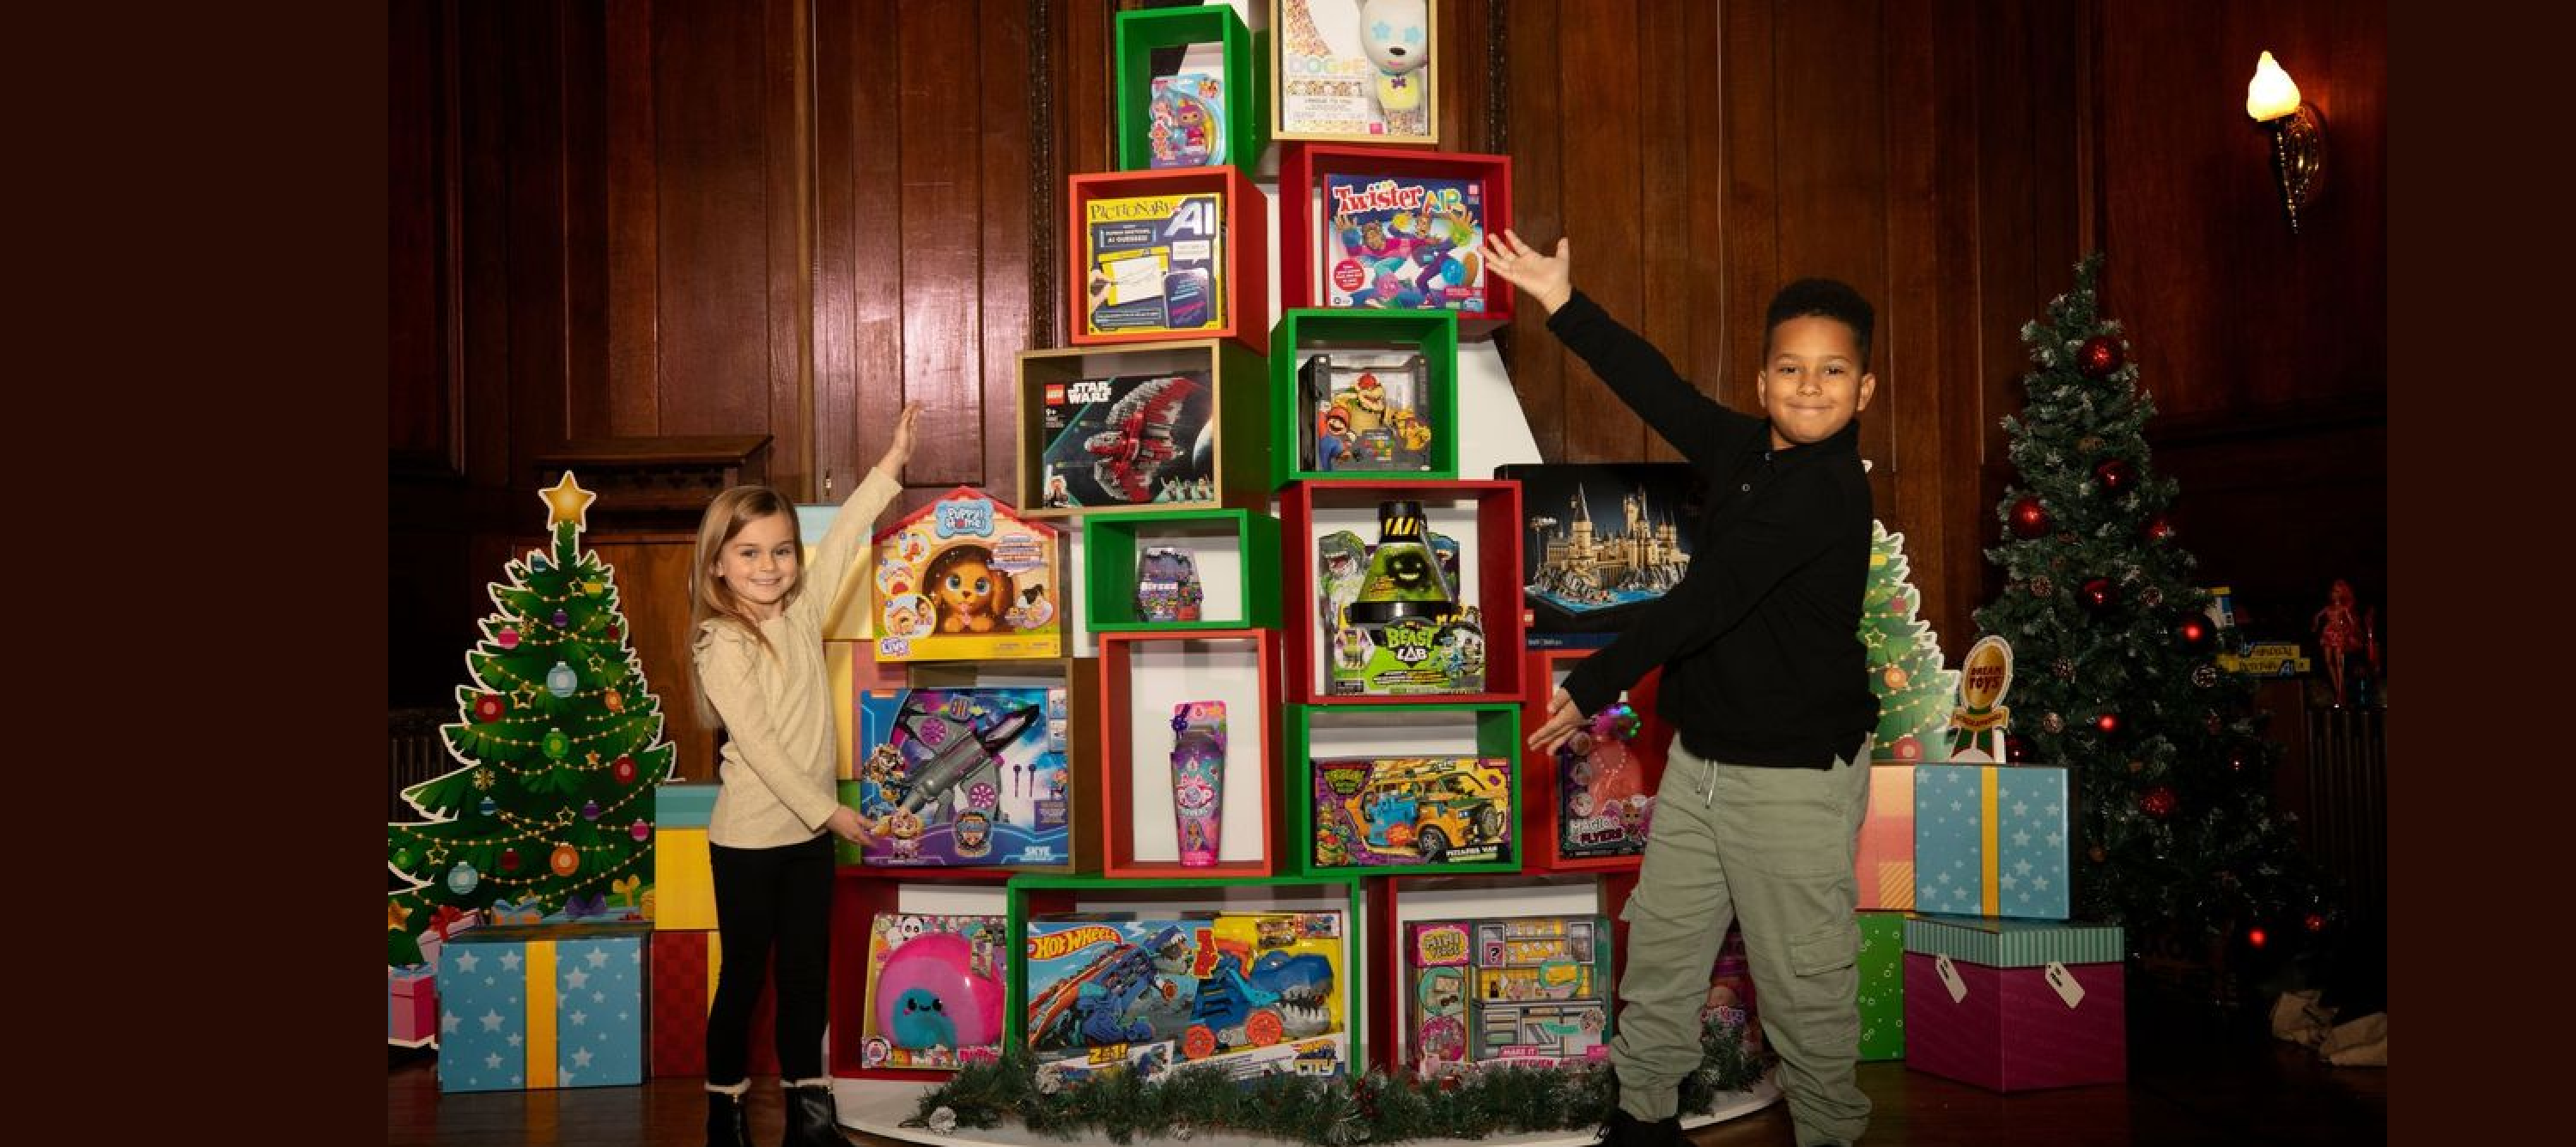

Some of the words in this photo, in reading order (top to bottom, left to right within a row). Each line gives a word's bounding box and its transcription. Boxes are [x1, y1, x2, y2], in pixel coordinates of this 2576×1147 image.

[1333, 182, 1424, 213] Twister
[1163, 201, 1215, 237] AI
[1072, 381, 1111, 394] STAR
[1067, 390, 1111, 404] WARS
[1384, 625, 1441, 648] BEAST
[1396, 646, 1429, 662] LAB
[1971, 665, 2002, 676] DREAM
[1969, 676, 2002, 693] TOYS
[1024, 846, 1051, 857] SKYE
[1035, 934, 1067, 959] HOT
[1063, 926, 1116, 953] WHEELS
